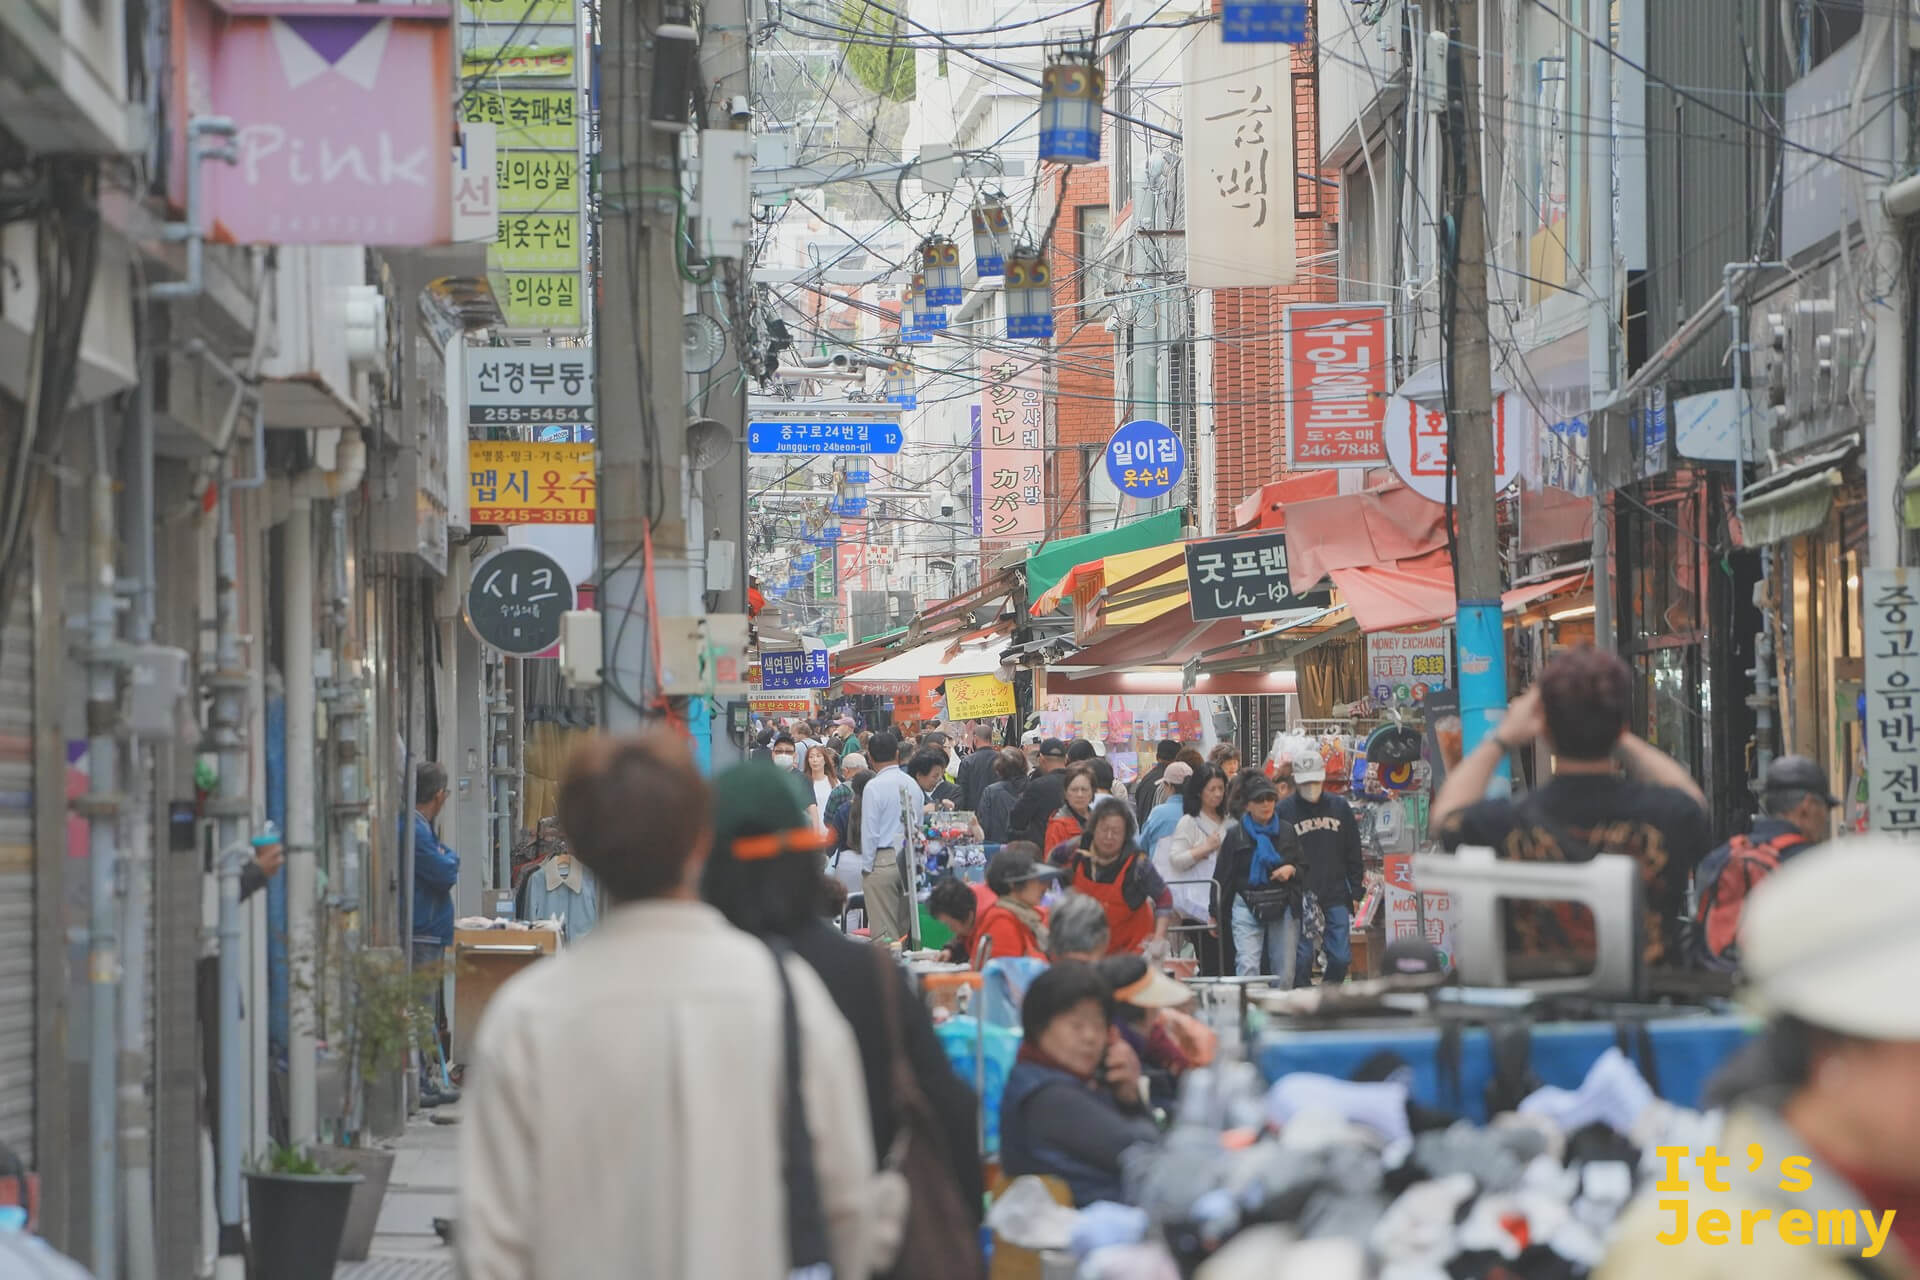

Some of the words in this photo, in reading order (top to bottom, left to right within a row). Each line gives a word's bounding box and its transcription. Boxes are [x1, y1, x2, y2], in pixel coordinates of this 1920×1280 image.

[238, 123, 430, 186] Pink
[478, 362, 594, 396] 선경부동
[484, 408, 580, 421] 255-5454
[752, 433, 760, 443] 8
[776, 442, 821, 453] Junggu-ro
[823, 442, 872, 453] 24beon-gil
[885, 433, 897, 444] 12
[1300, 442, 1380, 457] 246-7848
[1112, 437, 1177, 466] 일이집
[472, 469, 529, 503] 맵시
[1022, 465, 1042, 505] 가방
[1123, 467, 1169, 488] 옷수선
[991, 469, 1020, 534] カバン
[494, 509, 590, 522] 245-3518
[482, 568, 559, 602] 시크
[1873, 586, 1919, 659] 중고
[1371, 636, 1400, 650] MONEY
[1402, 635, 1446, 649] EXCHANGE
